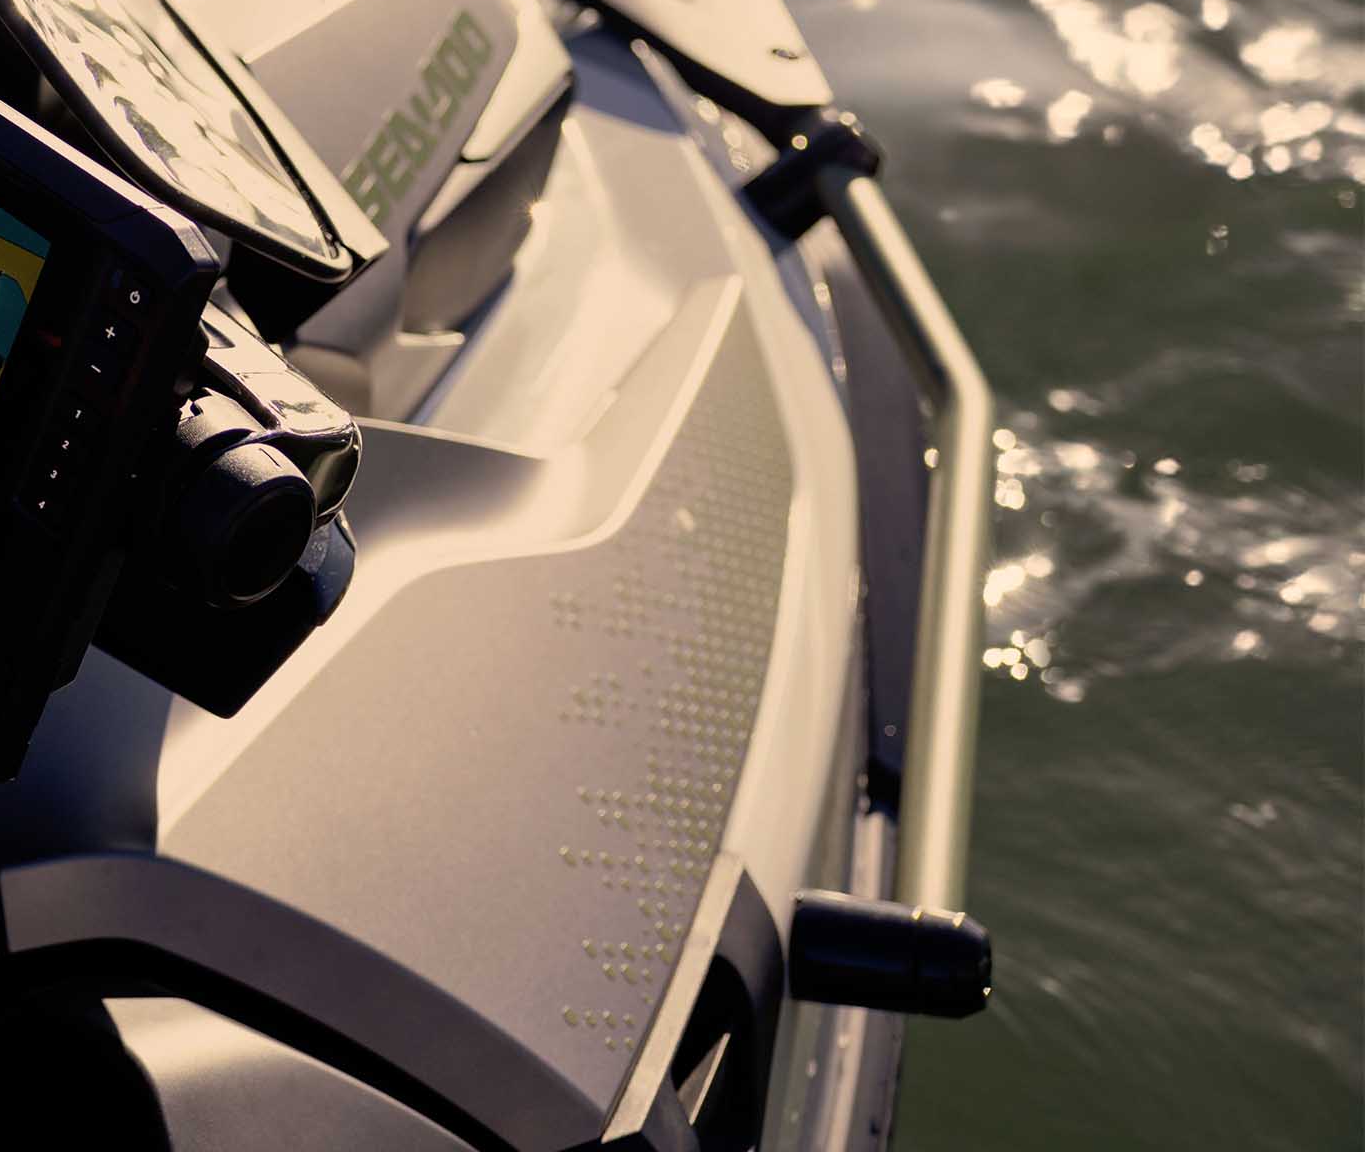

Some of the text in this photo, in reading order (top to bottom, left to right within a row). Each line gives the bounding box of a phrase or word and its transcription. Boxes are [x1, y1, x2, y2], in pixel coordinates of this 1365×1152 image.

[75, 410, 82, 418] 1
[61, 440, 70, 450] 2
[49, 469, 58, 479] 3
[38, 500, 46, 509] 4
